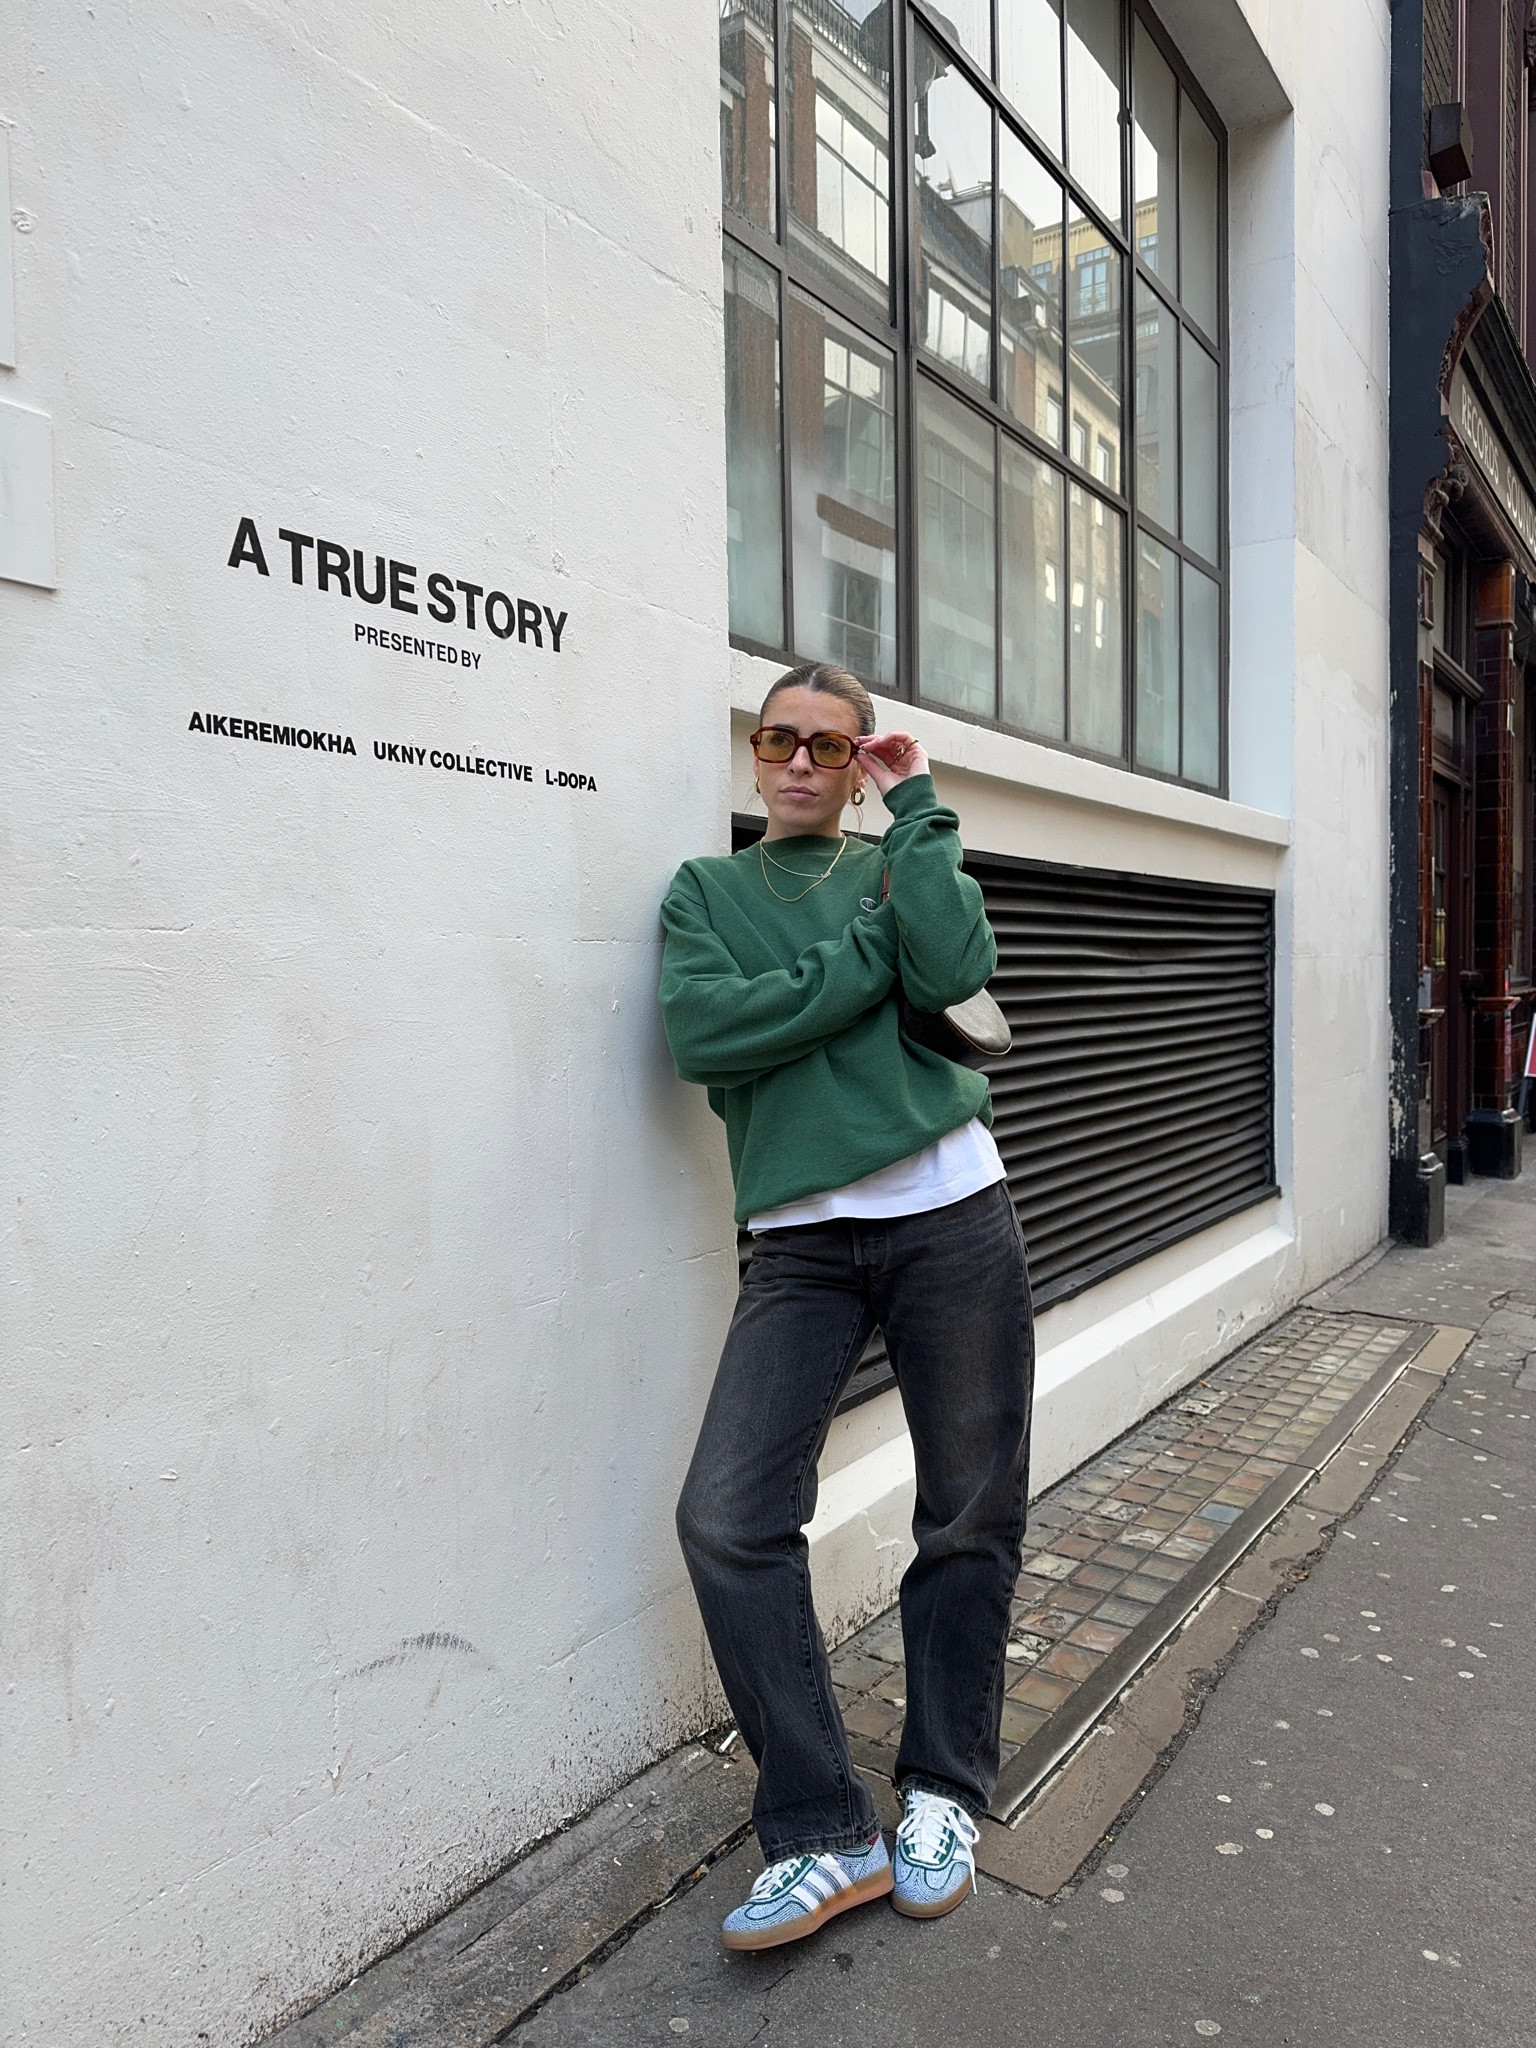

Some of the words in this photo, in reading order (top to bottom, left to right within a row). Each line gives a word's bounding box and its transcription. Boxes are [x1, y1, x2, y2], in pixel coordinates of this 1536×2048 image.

[1461, 384, 1499, 485] RECORDS
[227, 516, 270, 577] A
[278, 527, 419, 615] TRUE
[426, 572, 568, 653] STORY
[354, 623, 459, 664] PRESENTED
[461, 649, 481, 670] BY
[188, 711, 357, 756] AIKEREMIOKHA
[373, 741, 427, 766] UKNY
[429, 750, 533, 783] COLLECTIVE
[545, 769, 598, 792] L-DOPA
